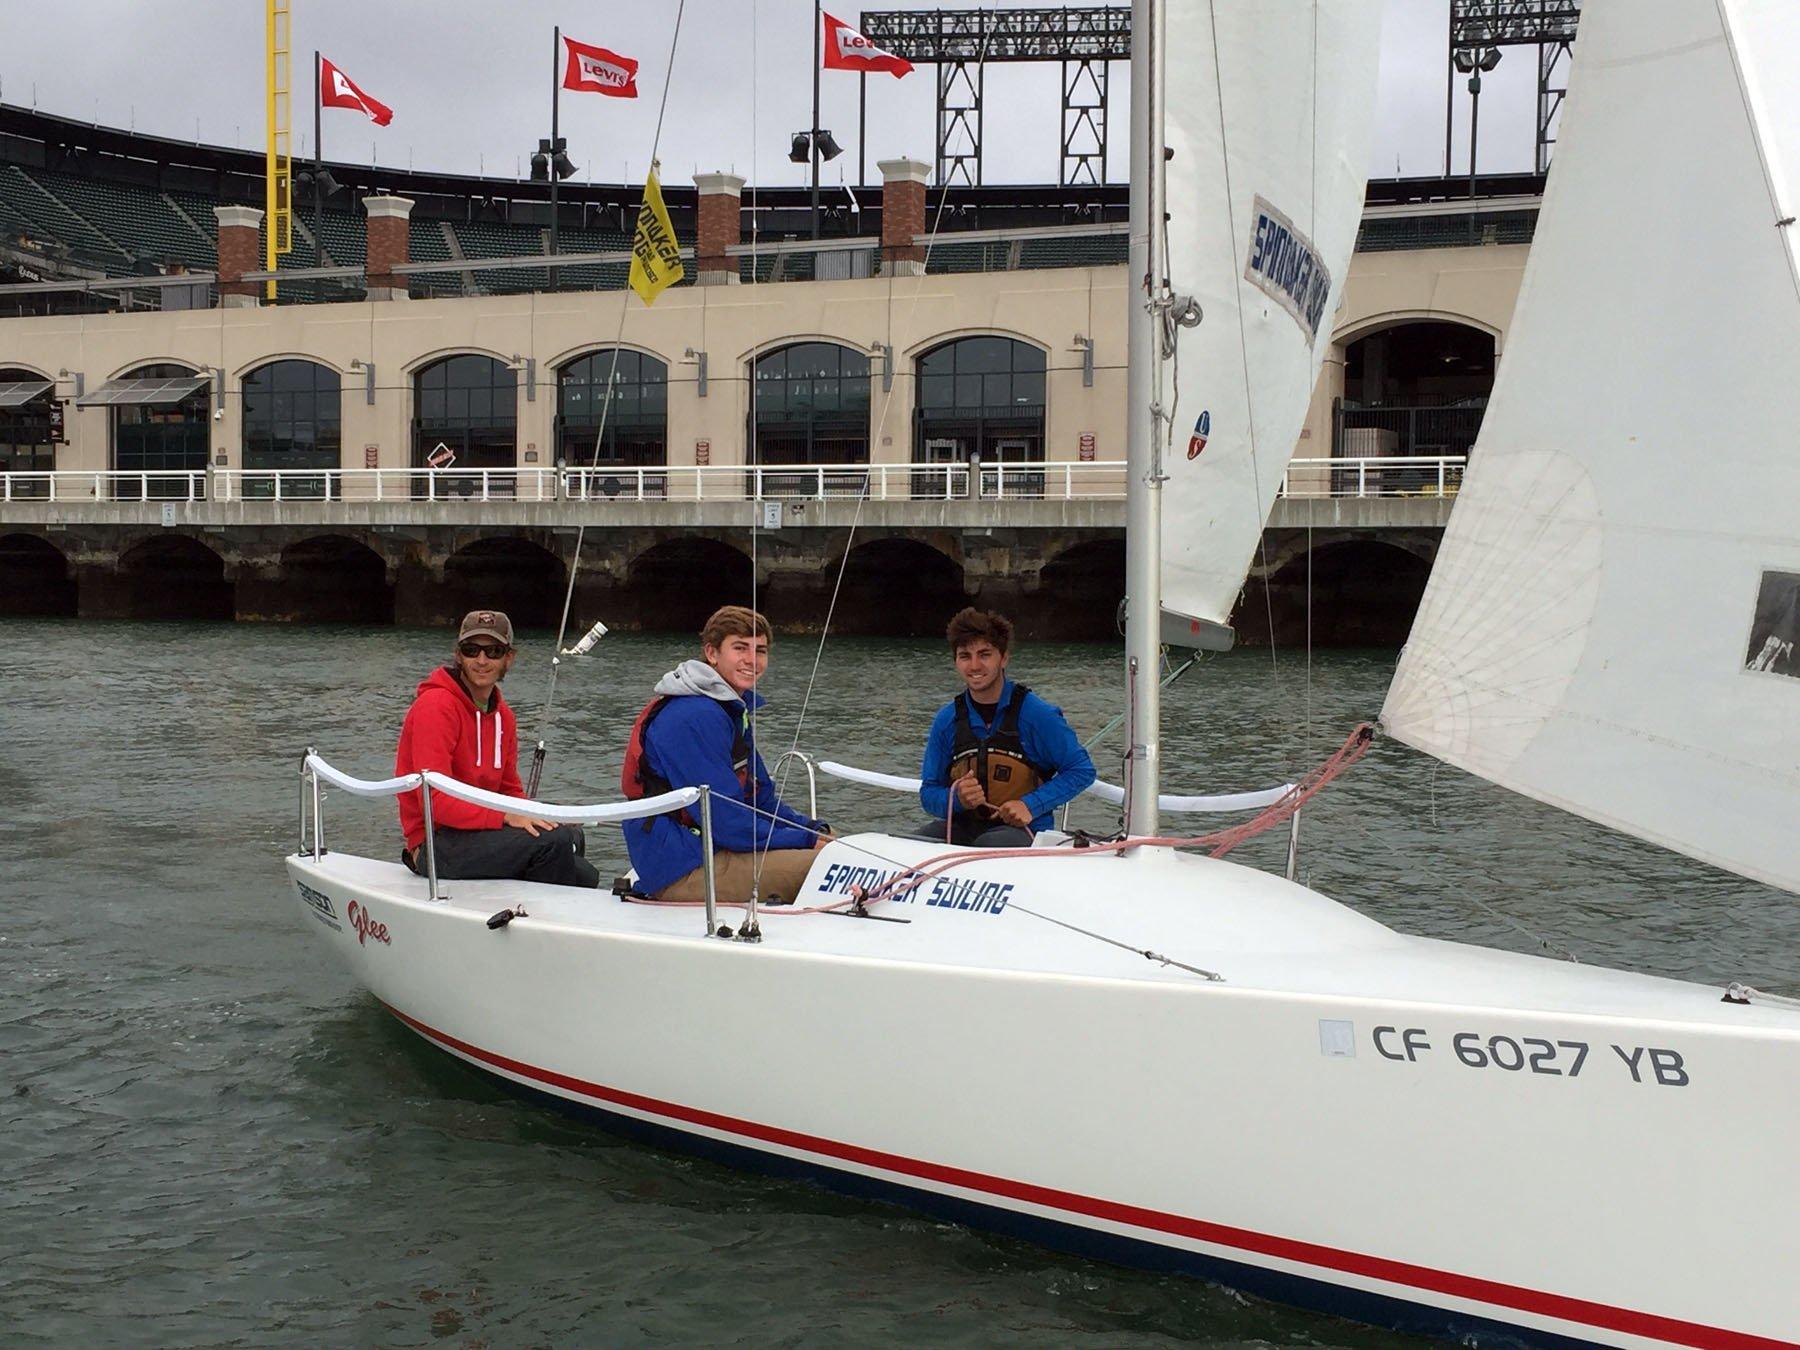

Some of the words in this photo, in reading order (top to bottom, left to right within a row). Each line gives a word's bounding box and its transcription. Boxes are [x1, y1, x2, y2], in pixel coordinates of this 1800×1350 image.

[926, 877, 1015, 915] SAILING
[348, 900, 391, 945] Glee
[1372, 1026, 1431, 1062] CF
[1452, 1032, 1589, 1077] 6027
[1610, 1044, 1690, 1087] YB
